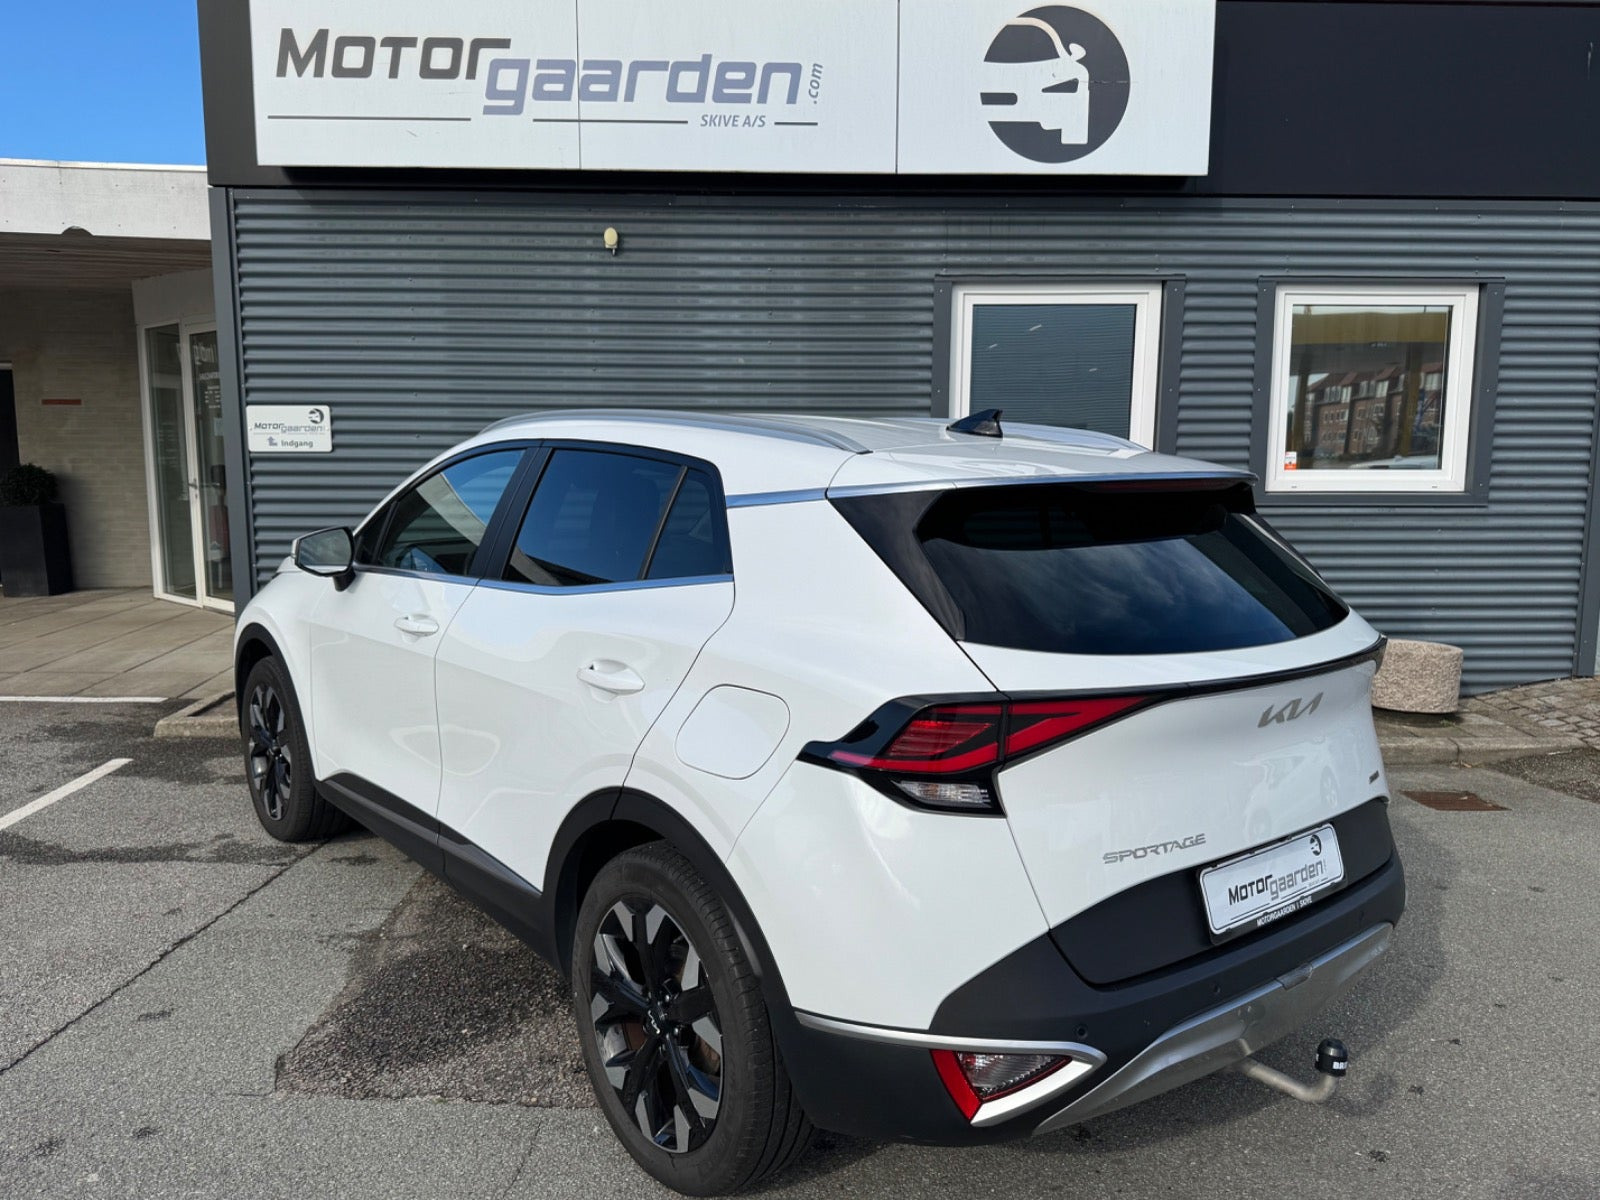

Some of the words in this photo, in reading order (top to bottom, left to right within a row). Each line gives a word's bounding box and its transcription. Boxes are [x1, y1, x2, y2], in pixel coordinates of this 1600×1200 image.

[808, 63, 824, 105] .com
[700, 114, 740, 127] SKIVE
[742, 114, 766, 128] A/S
[281, 440, 313, 448] Indgang
[1257, 692, 1324, 729] KIA
[1102, 833, 1206, 864] SPORTAGE
